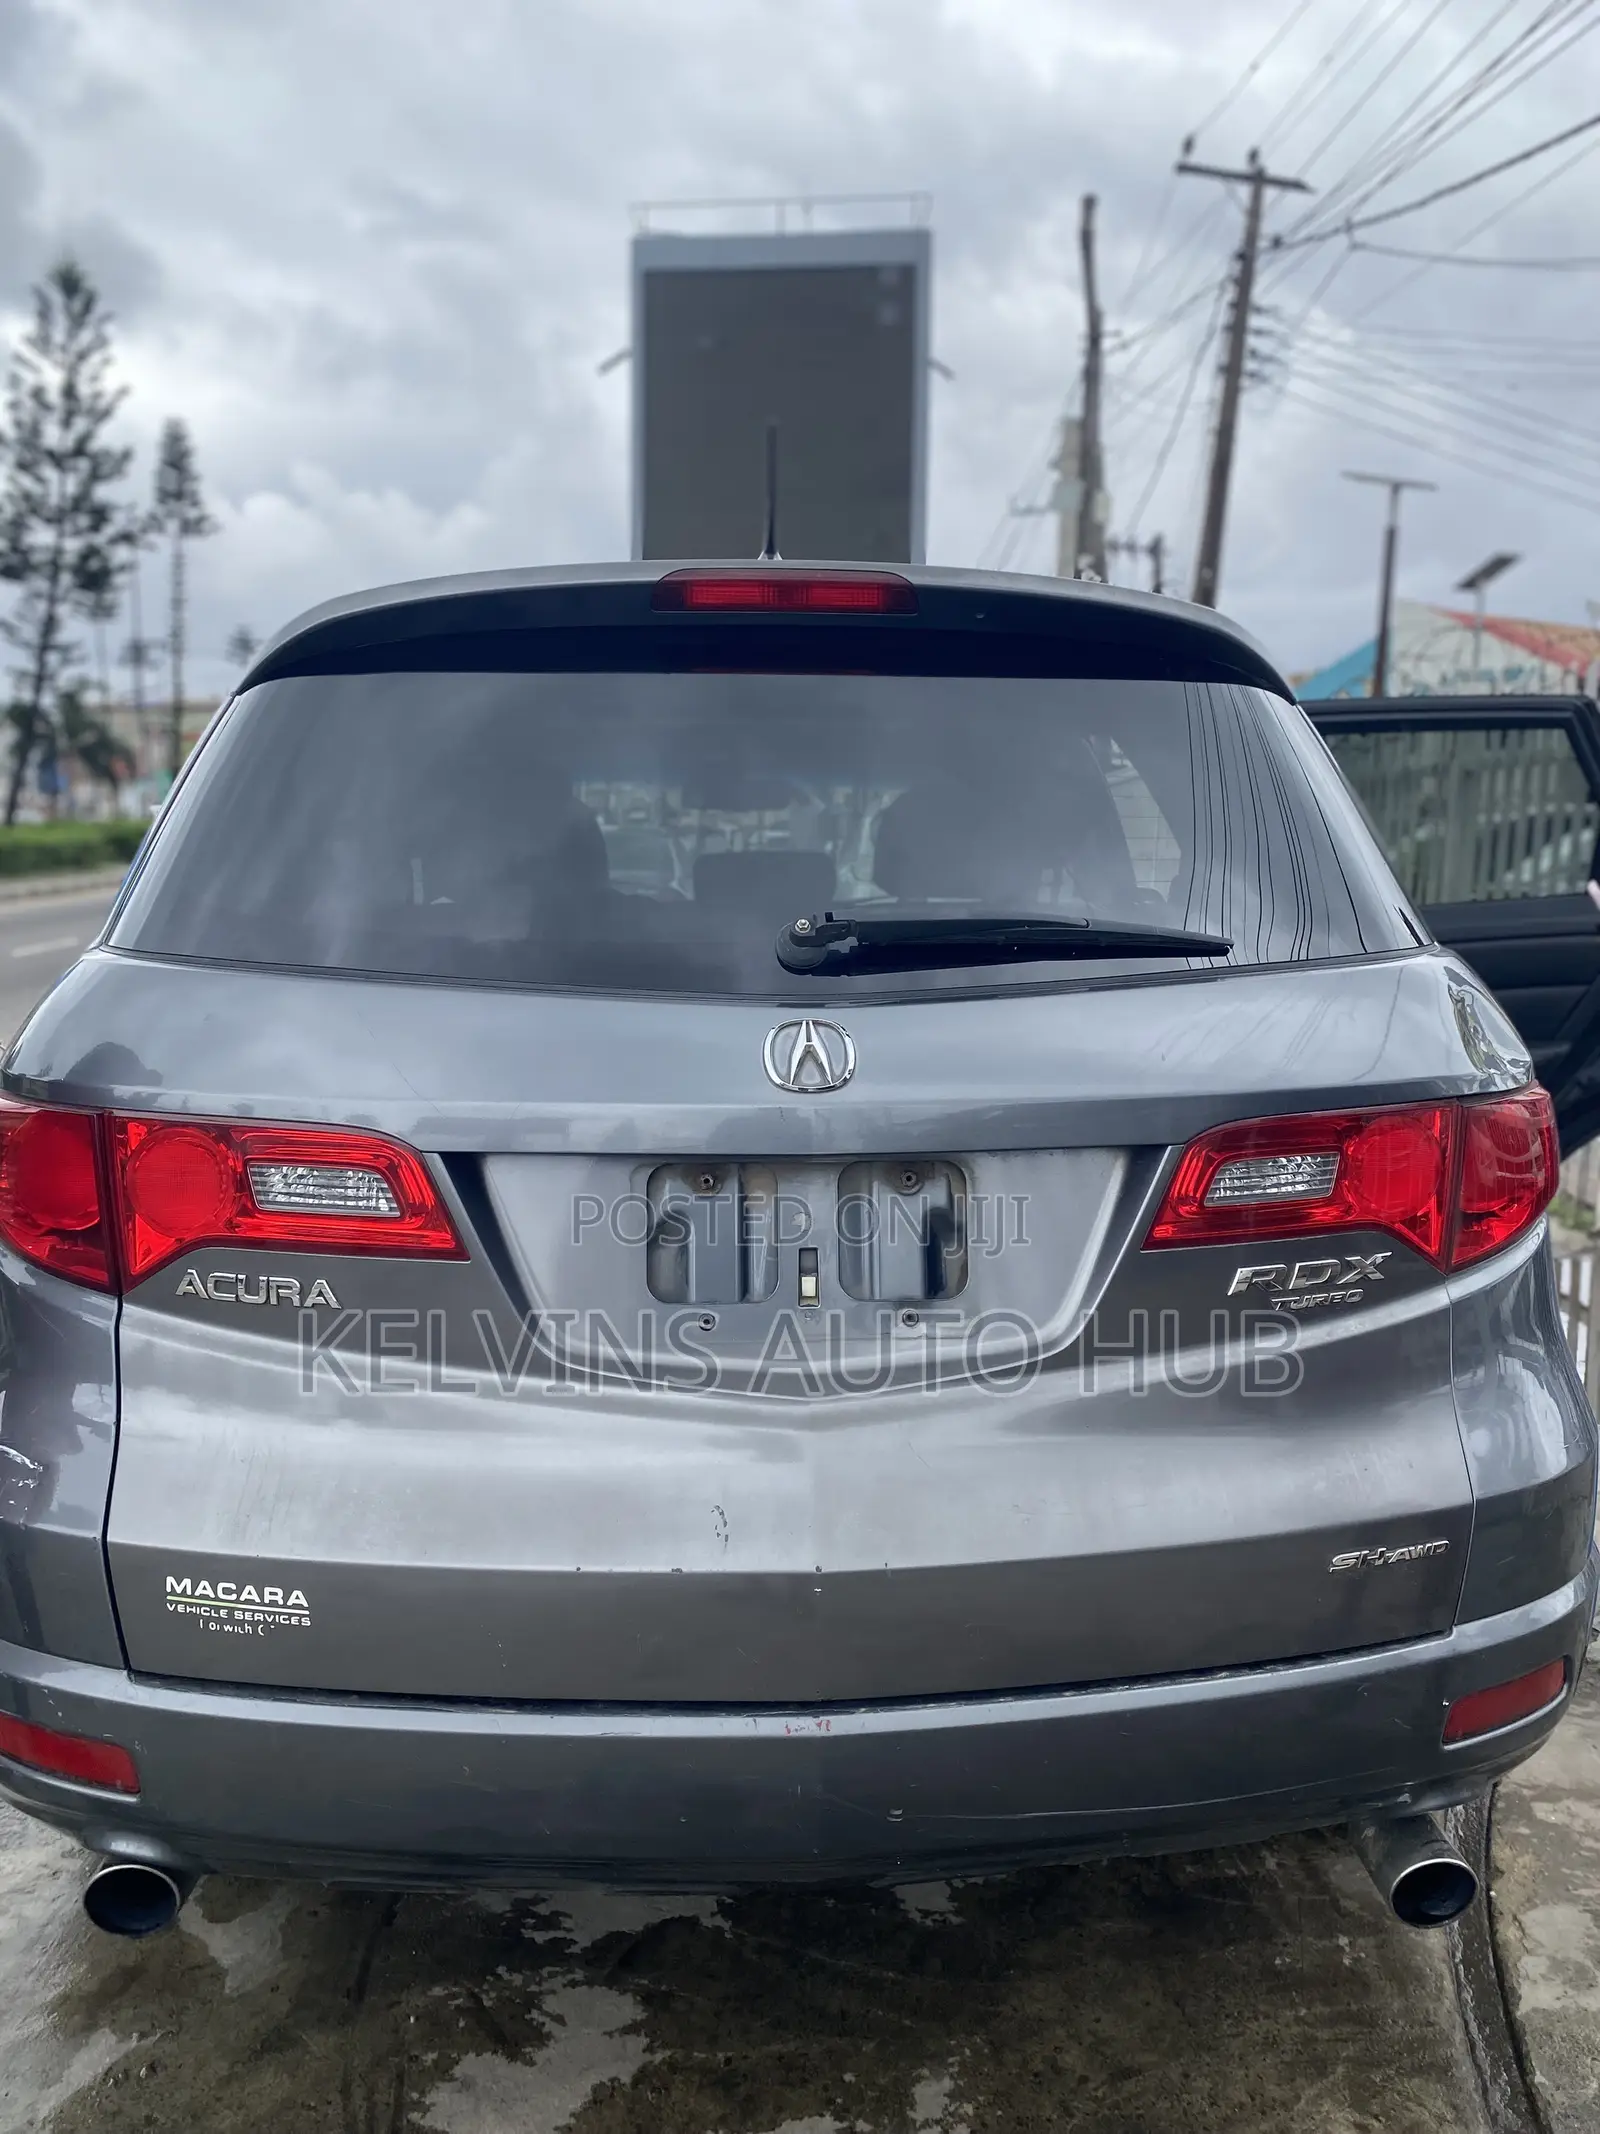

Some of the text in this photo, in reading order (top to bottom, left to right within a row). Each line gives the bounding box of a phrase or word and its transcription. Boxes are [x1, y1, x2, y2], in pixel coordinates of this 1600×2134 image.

[175, 1268, 342, 1310] ACURA
[1226, 1251, 1393, 1296] RDX
[1271, 1288, 1364, 1311] TURBO
[1328, 1540, 1450, 1573] SH-AWD
[165, 1575, 309, 1608] MACARA
[166, 1602, 312, 1627] VEHICLE SERVICES
